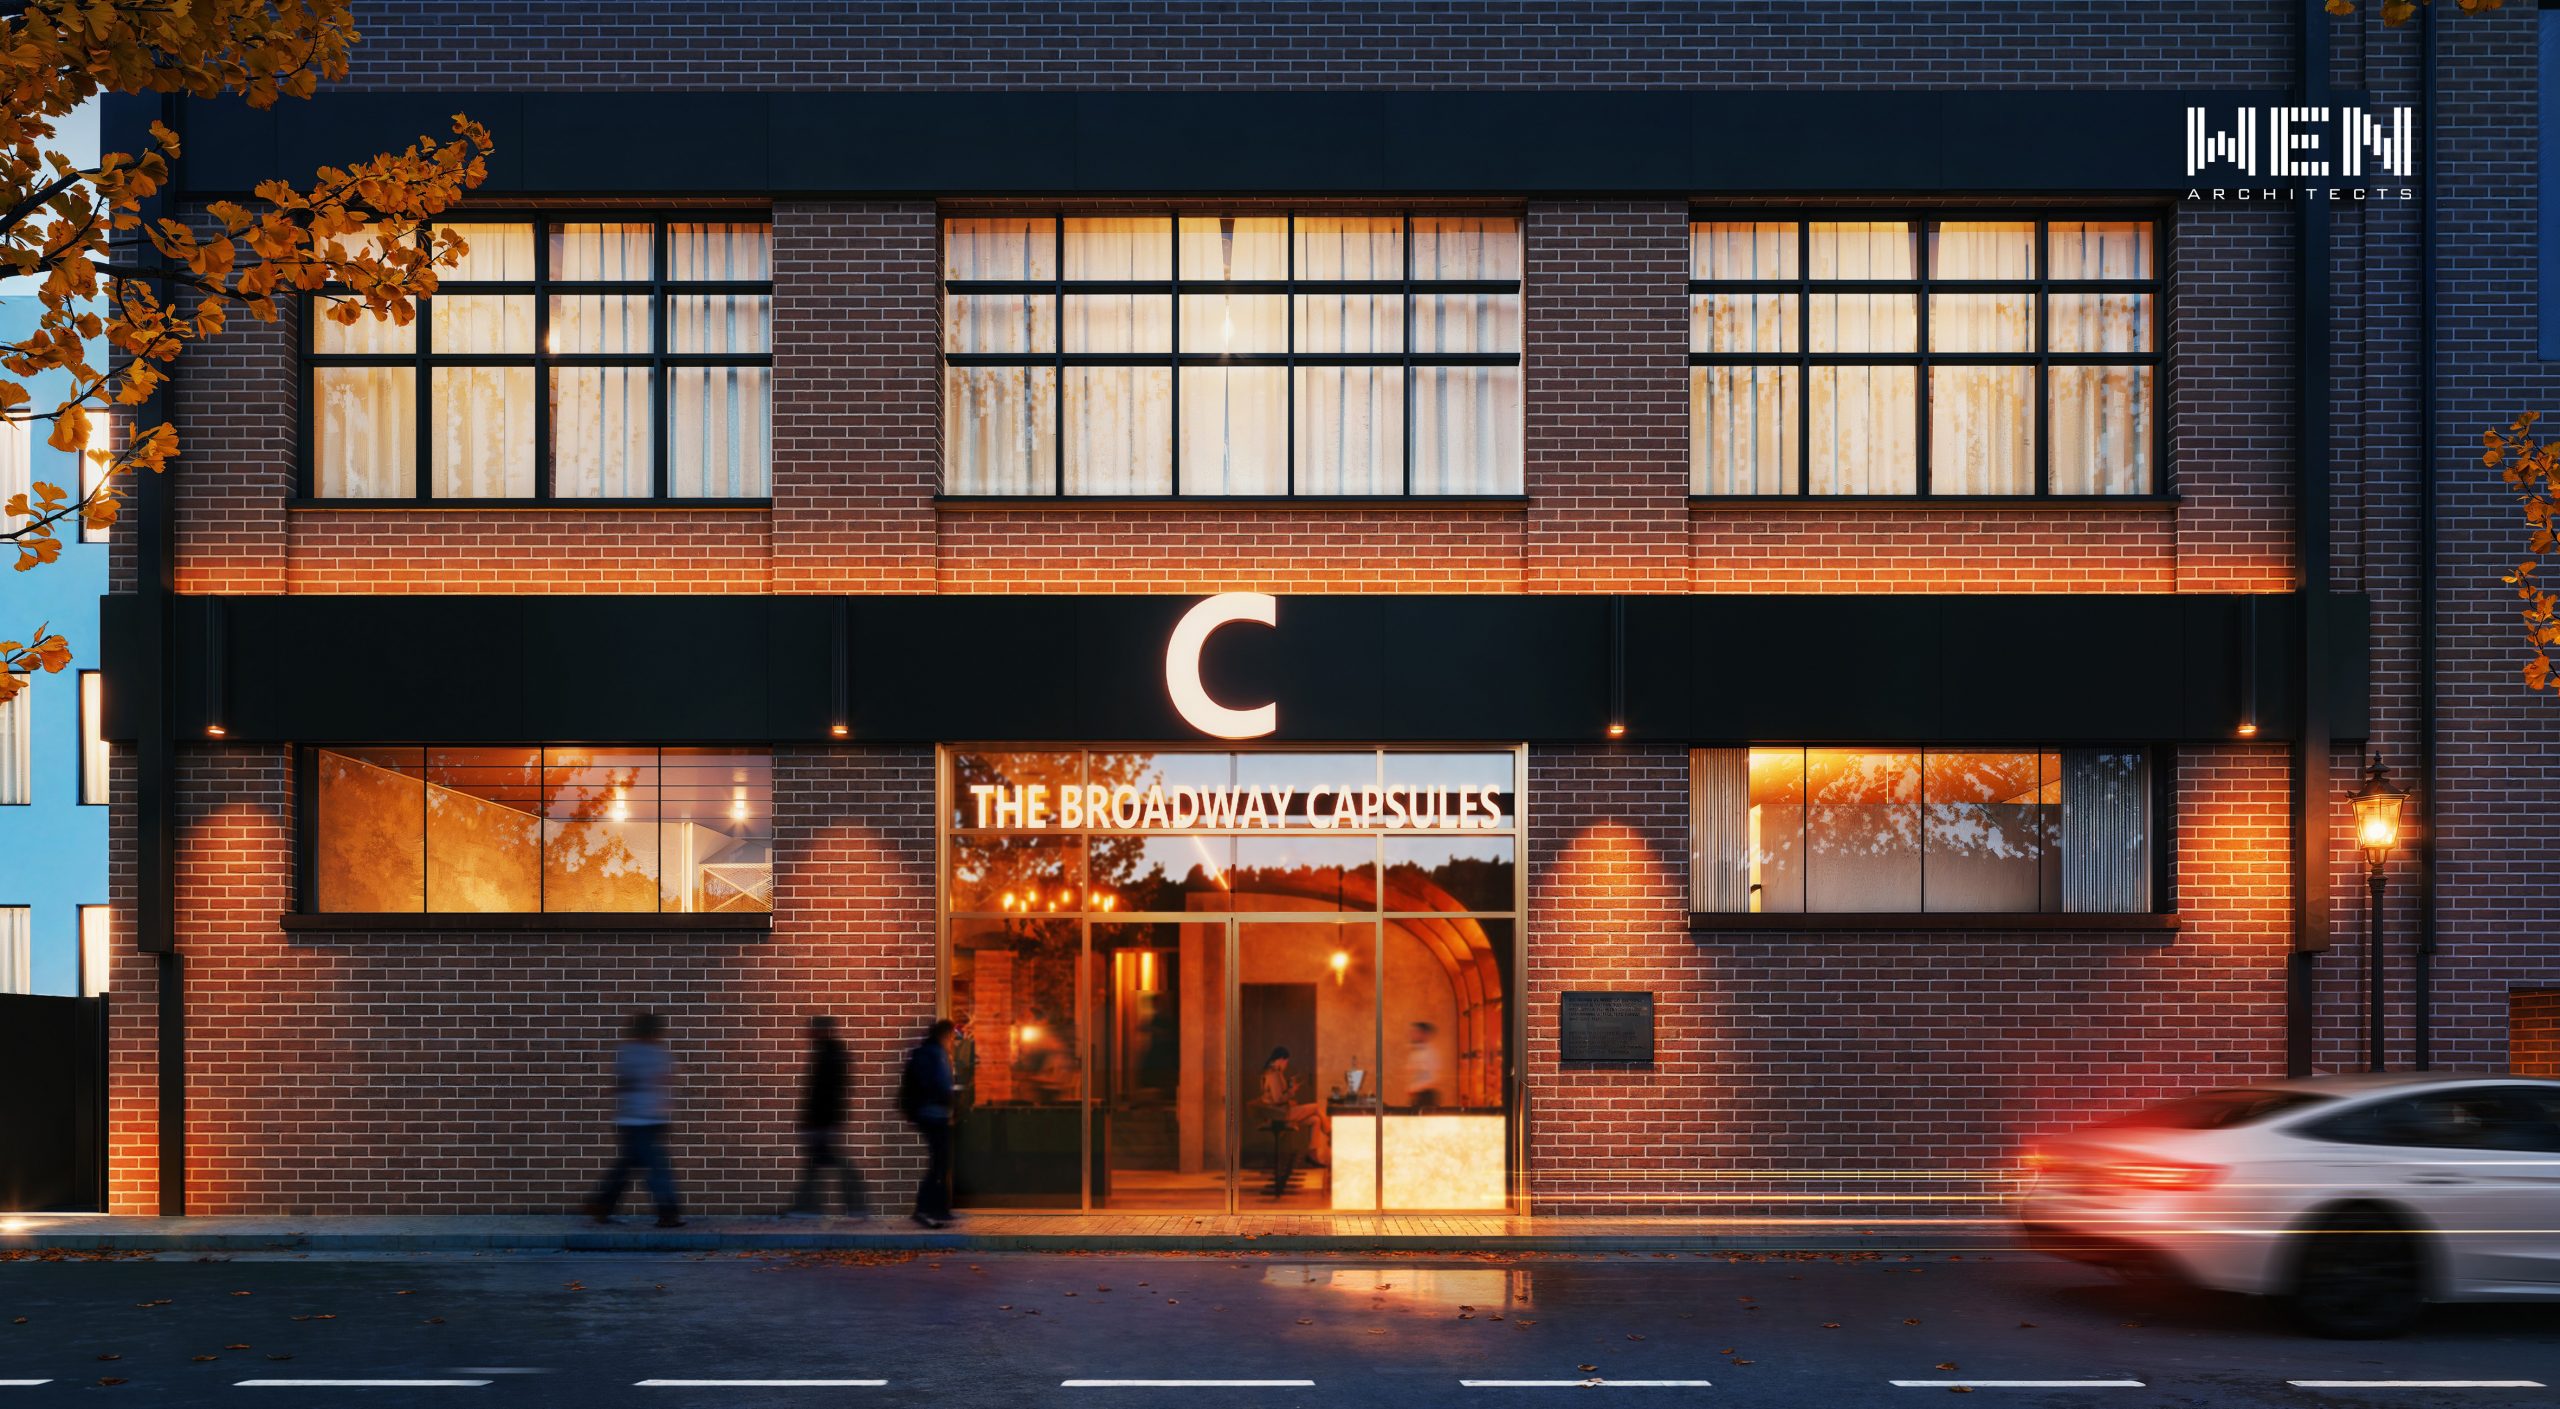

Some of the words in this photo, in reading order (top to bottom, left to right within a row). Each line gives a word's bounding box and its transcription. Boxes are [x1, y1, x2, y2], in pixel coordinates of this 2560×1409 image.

[1166, 591, 1276, 740] C
[970, 785, 1047, 829] THE
[1060, 785, 1294, 829] BROADWAY
[1306, 785, 1501, 829] CAPSULES
